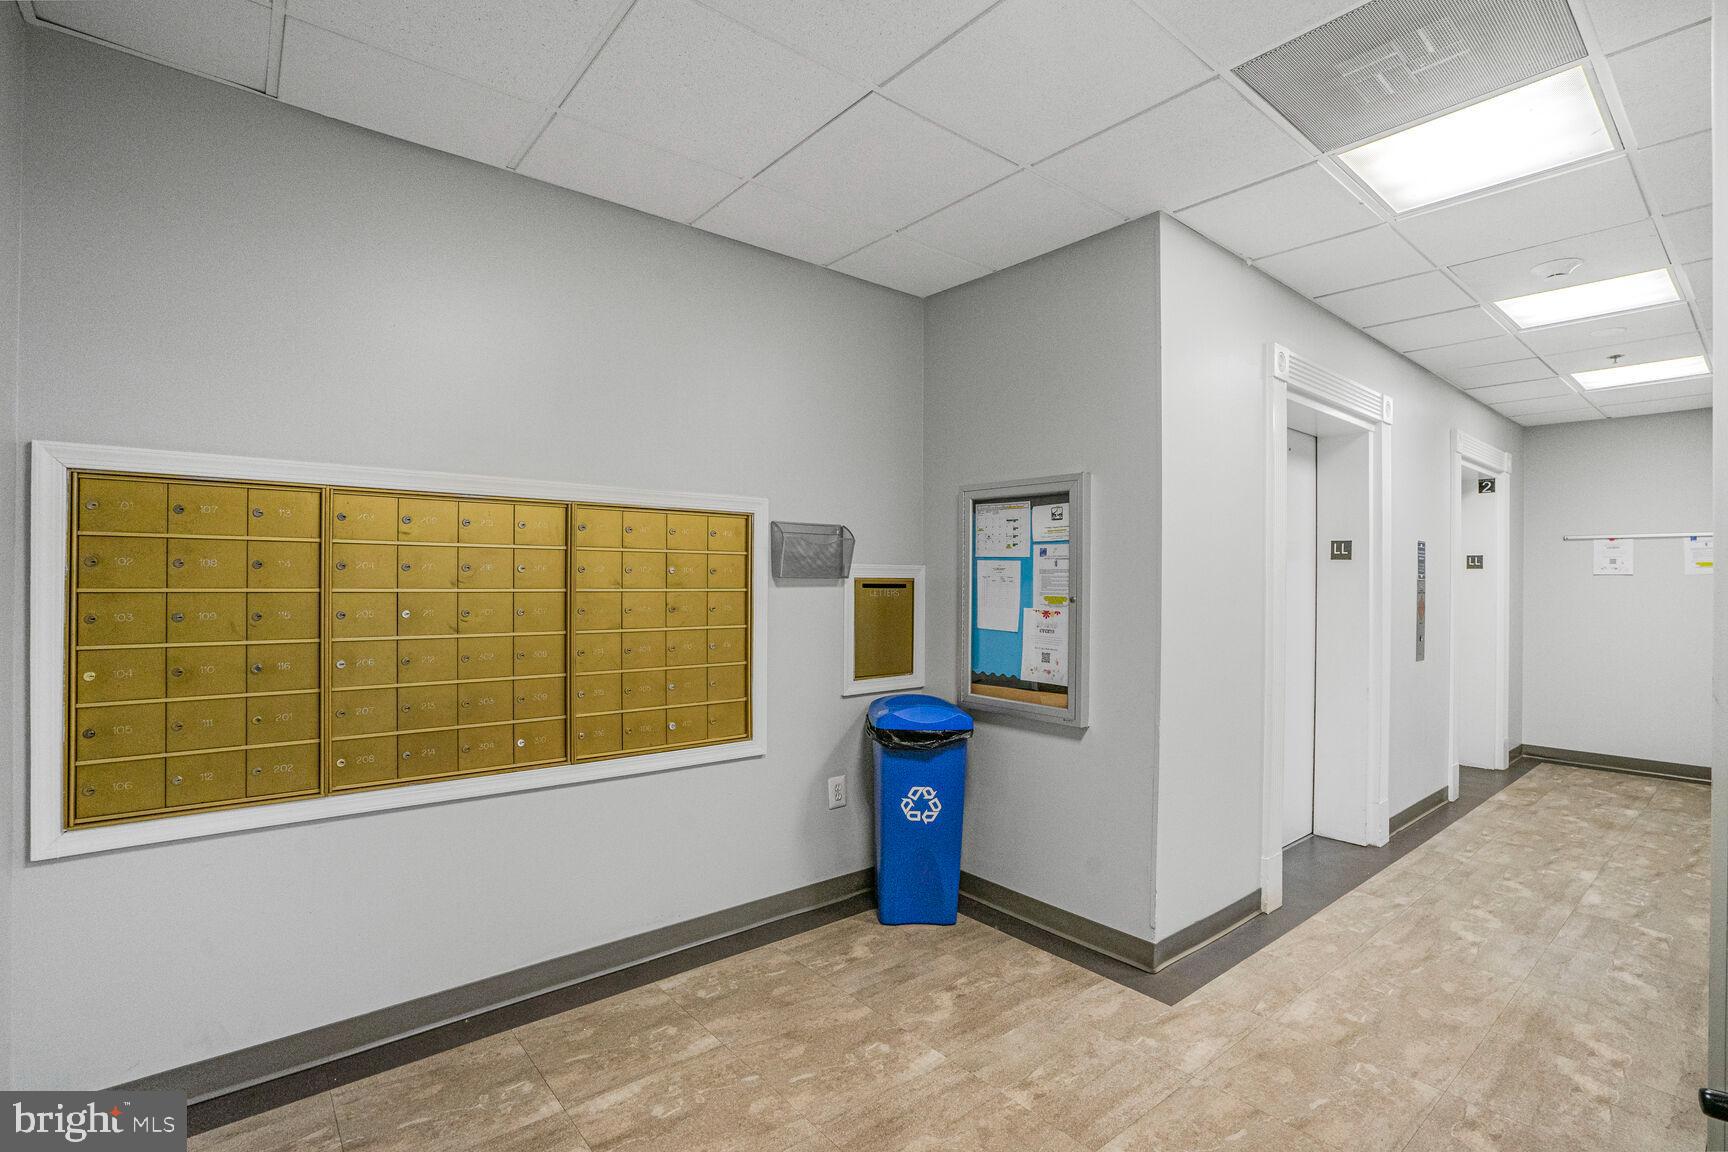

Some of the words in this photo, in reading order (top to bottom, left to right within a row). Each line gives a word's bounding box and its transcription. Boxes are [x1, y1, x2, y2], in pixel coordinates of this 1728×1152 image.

[1482, 482, 1491, 492] 2
[200, 505, 219, 514] 107
[1334, 543, 1348, 554] LL
[199, 559, 218, 567] 108
[1469, 557, 1480, 566] LL
[199, 612, 217, 621] 109
[200, 666, 214, 674] 110
[277, 662, 290, 670] 116
[112, 669, 132, 679] 104
[356, 707, 374, 716] 207
[275, 712, 292, 722] 201
[201, 719, 213, 728] 111
[112, 725, 132, 735] 105
[356, 755, 374, 764] 208
[273, 764, 293, 774] 202
[200, 772, 213, 781] 112
[112, 782, 132, 792] 106
